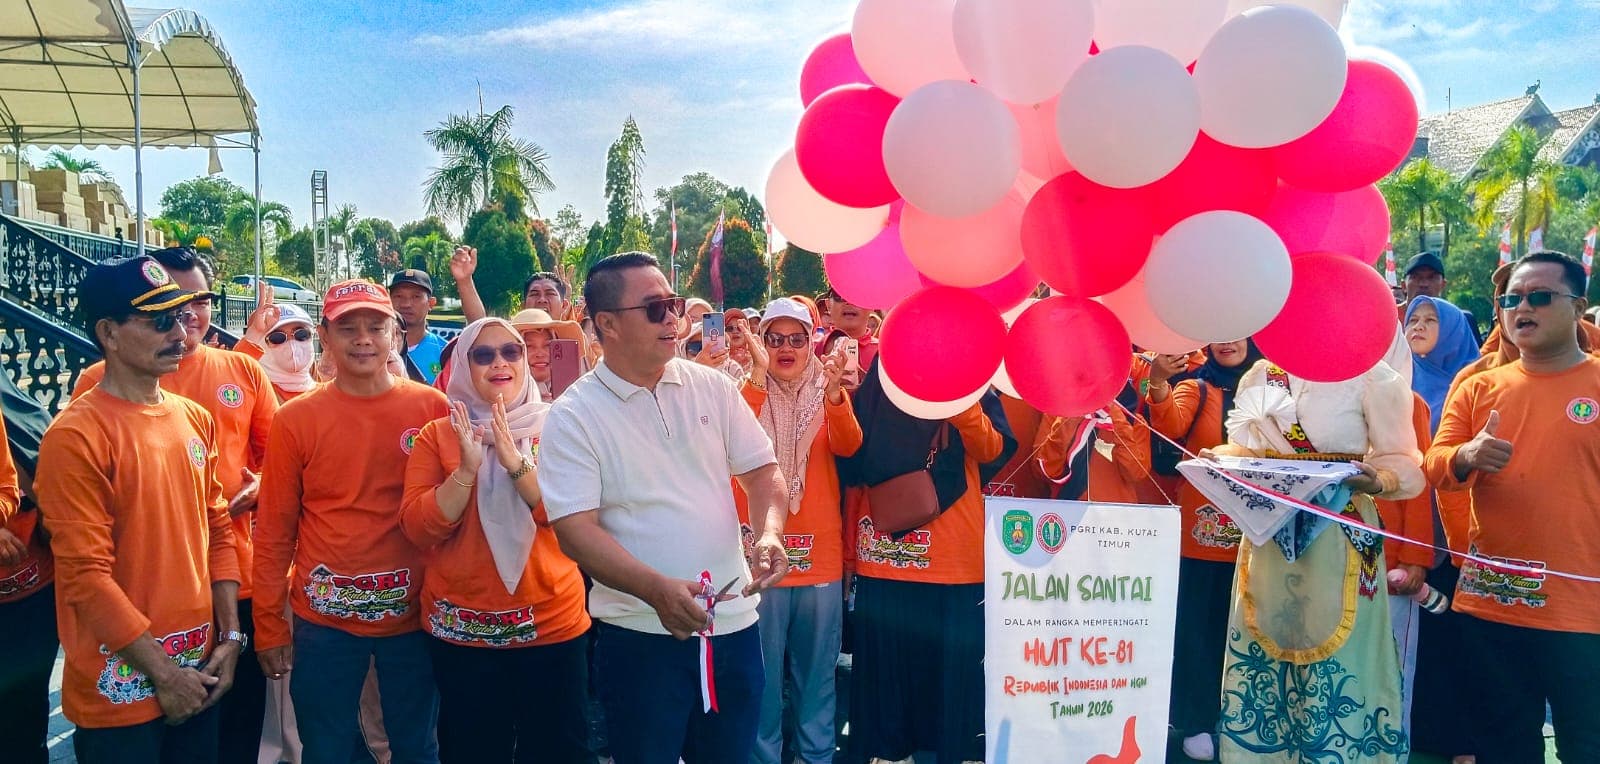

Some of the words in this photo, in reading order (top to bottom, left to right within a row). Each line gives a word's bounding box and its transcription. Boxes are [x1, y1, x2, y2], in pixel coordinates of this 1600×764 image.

[1070, 525, 1096, 535] PGRI
[1099, 526, 1124, 536] KAB.
[1127, 528, 1158, 538] KUTAI
[1097, 539, 1131, 549] TIMUR
[331, 569, 409, 592] PGRI
[1001, 571, 1070, 602] JALAN
[1076, 574, 1152, 603] SANTAI
[458, 606, 534, 627] PGRI
[1004, 619, 1041, 627] DALAM
[1045, 618, 1080, 627] RANGKA
[1082, 618, 1149, 627] MEMPERINGATI
[156, 623, 211, 657] GRI
[1024, 637, 1072, 667] HUT
[1079, 636, 1135, 666] KE-81
[1111, 678, 1128, 689] DAN
[1087, 699, 1114, 718] 2026
